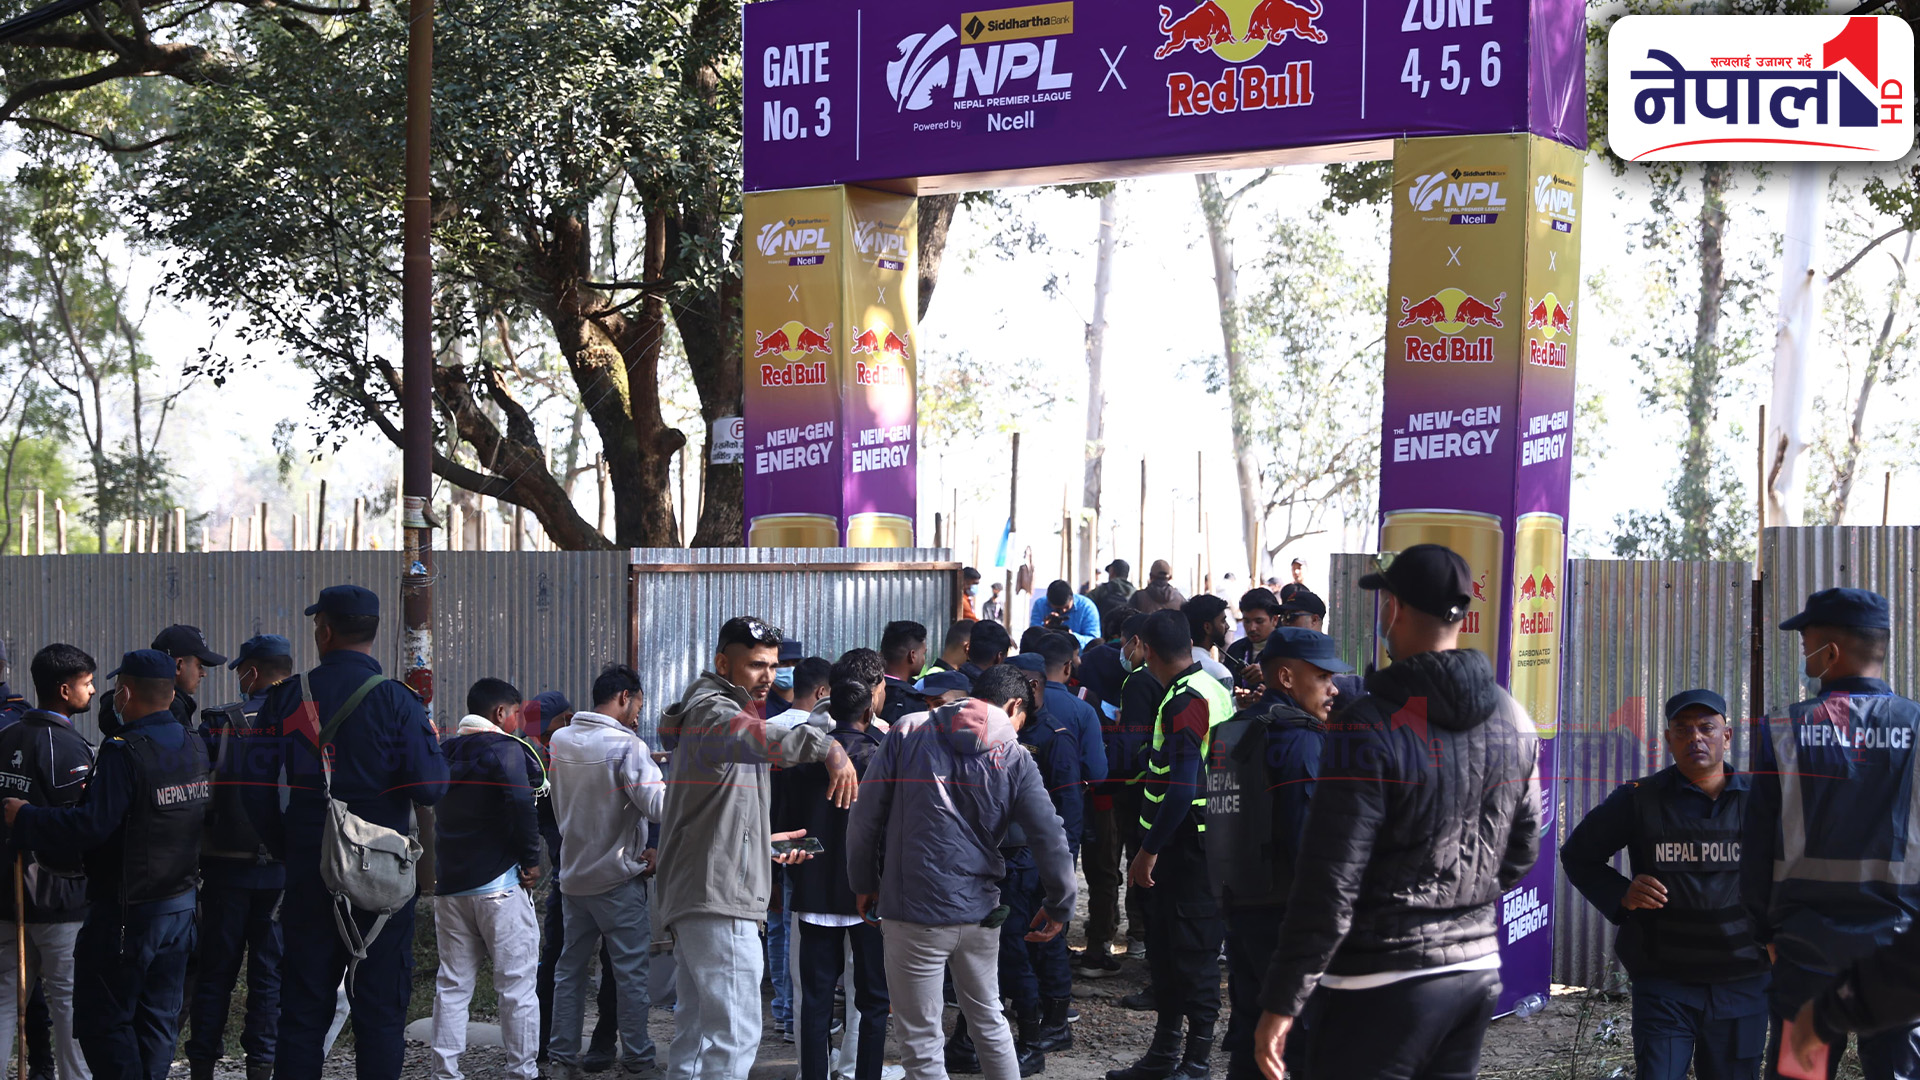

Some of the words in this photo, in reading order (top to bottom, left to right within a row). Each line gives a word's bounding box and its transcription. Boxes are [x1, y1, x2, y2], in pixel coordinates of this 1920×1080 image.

[1401, 0, 1494, 32] ZONE
[763, 41, 830, 88] GATE
[953, 39, 1073, 98] NPL
[1401, 48, 1430, 99] 4,
[1440, 44, 1471, 96] 5,
[1480, 41, 1501, 88] 6
[953, 100, 985, 111] NEPAL
[986, 96, 1030, 108] PREMIER
[1031, 91, 1072, 103] LEAGUE
[1167, 68, 1239, 116] Red
[1238, 60, 1315, 111] Bull
[763, 99, 808, 142] No.
[815, 96, 831, 138] 3
[913, 120, 949, 132] Powered
[950, 119, 962, 130] by
[987, 110, 1035, 133] Ncell
[1443, 181, 1507, 207] NPL
[1549, 187, 1576, 217] NPL
[1461, 214, 1487, 224] Ncell
[783, 228, 831, 251] NPL
[874, 231, 909, 257] NPL
[796, 256, 817, 266] Ncell
[883, 260, 899, 270] Ncell
[1405, 335, 1448, 363] Red
[1449, 336, 1494, 363] Bull
[1529, 338, 1548, 365] Red
[1548, 341, 1567, 369] Bull
[761, 363, 793, 387] Red
[794, 361, 827, 385] Bull
[856, 361, 880, 385] Red
[1409, 405, 1501, 432] NEW-GEN
[1529, 411, 1568, 436] NEW-GEN
[767, 421, 834, 447] NEW-GEN
[860, 424, 911, 446] NEW-GEN
[1393, 428, 1499, 462] ENERGY
[756, 441, 834, 475] ENERGY
[852, 444, 911, 473] ENERGY
[1522, 433, 1567, 467] ENERGY
[1459, 612, 1480, 634] ull
[1519, 611, 1536, 634] Red
[1537, 611, 1554, 634] Bull
[1517, 659, 1536, 667] ENERGY
[1536, 658, 1551, 666] DRINK
[1518, 648, 1551, 657] CARBONATED
[1800, 725, 1850, 747] NEPAL
[1855, 727, 1912, 749] POLICE
[156, 786, 188, 806] NEPAL
[188, 780, 210, 800] POLICE
[1206, 772, 1240, 792] NEPAL
[1206, 795, 1240, 815] POLICE
[1656, 843, 1698, 862] NEPAL
[1702, 843, 1740, 862] POLIC
[1503, 886, 1540, 926] BABAAL
[1508, 903, 1548, 945] ENERGY!!
